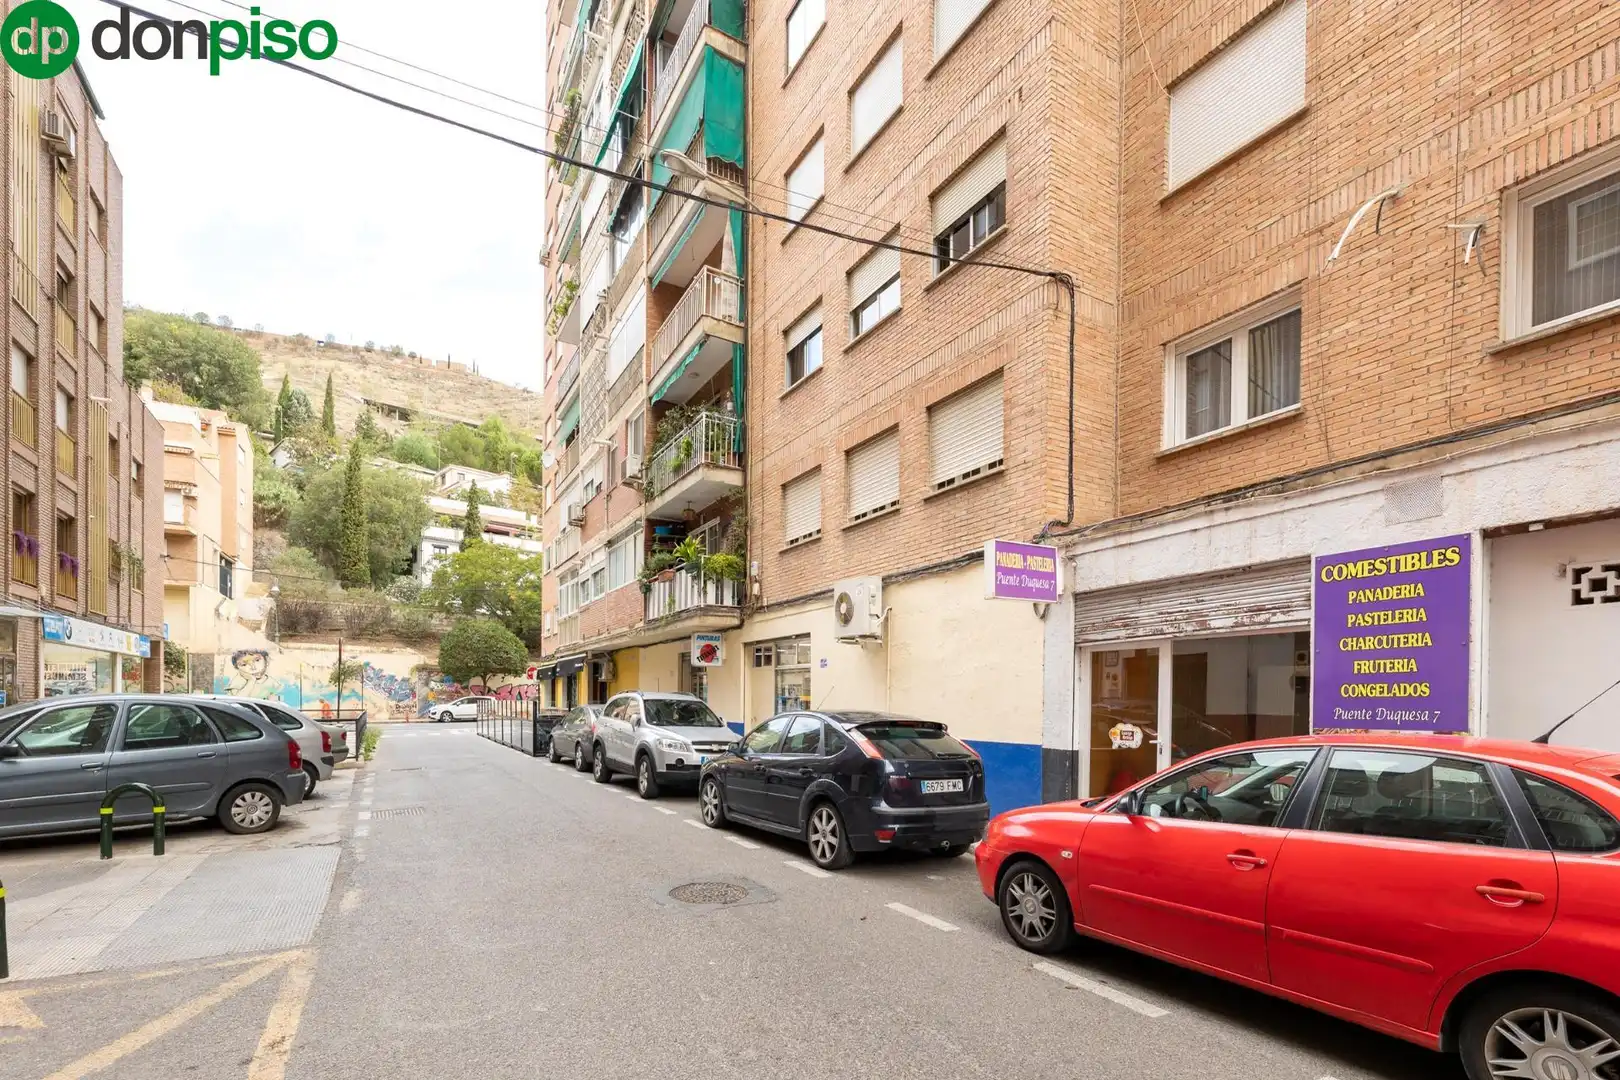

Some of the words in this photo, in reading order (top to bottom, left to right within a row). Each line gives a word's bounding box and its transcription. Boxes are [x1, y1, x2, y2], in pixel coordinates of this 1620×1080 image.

[996, 551, 1024, 569] PANADERIA
[1026, 555, 1055, 573] PASTELERIA
[1320, 546, 1461, 583] COMESTIBLES
[996, 571, 1020, 586] Puente
[1021, 574, 1050, 592] Duquesa
[1050, 580, 1055, 591] 7
[1348, 583, 1425, 604] PANADERIA
[1347, 608, 1428, 628] PASTELERIA
[1339, 632, 1433, 651] CHARCUTERIA
[1353, 658, 1418, 674] FRUTERIA
[1340, 683, 1431, 698] CONGELADOS
[1333, 707, 1372, 721] Puente
[1376, 707, 1429, 725] Duquesa
[1433, 711, 1441, 723] 7
[926, 781, 944, 792] 6679
